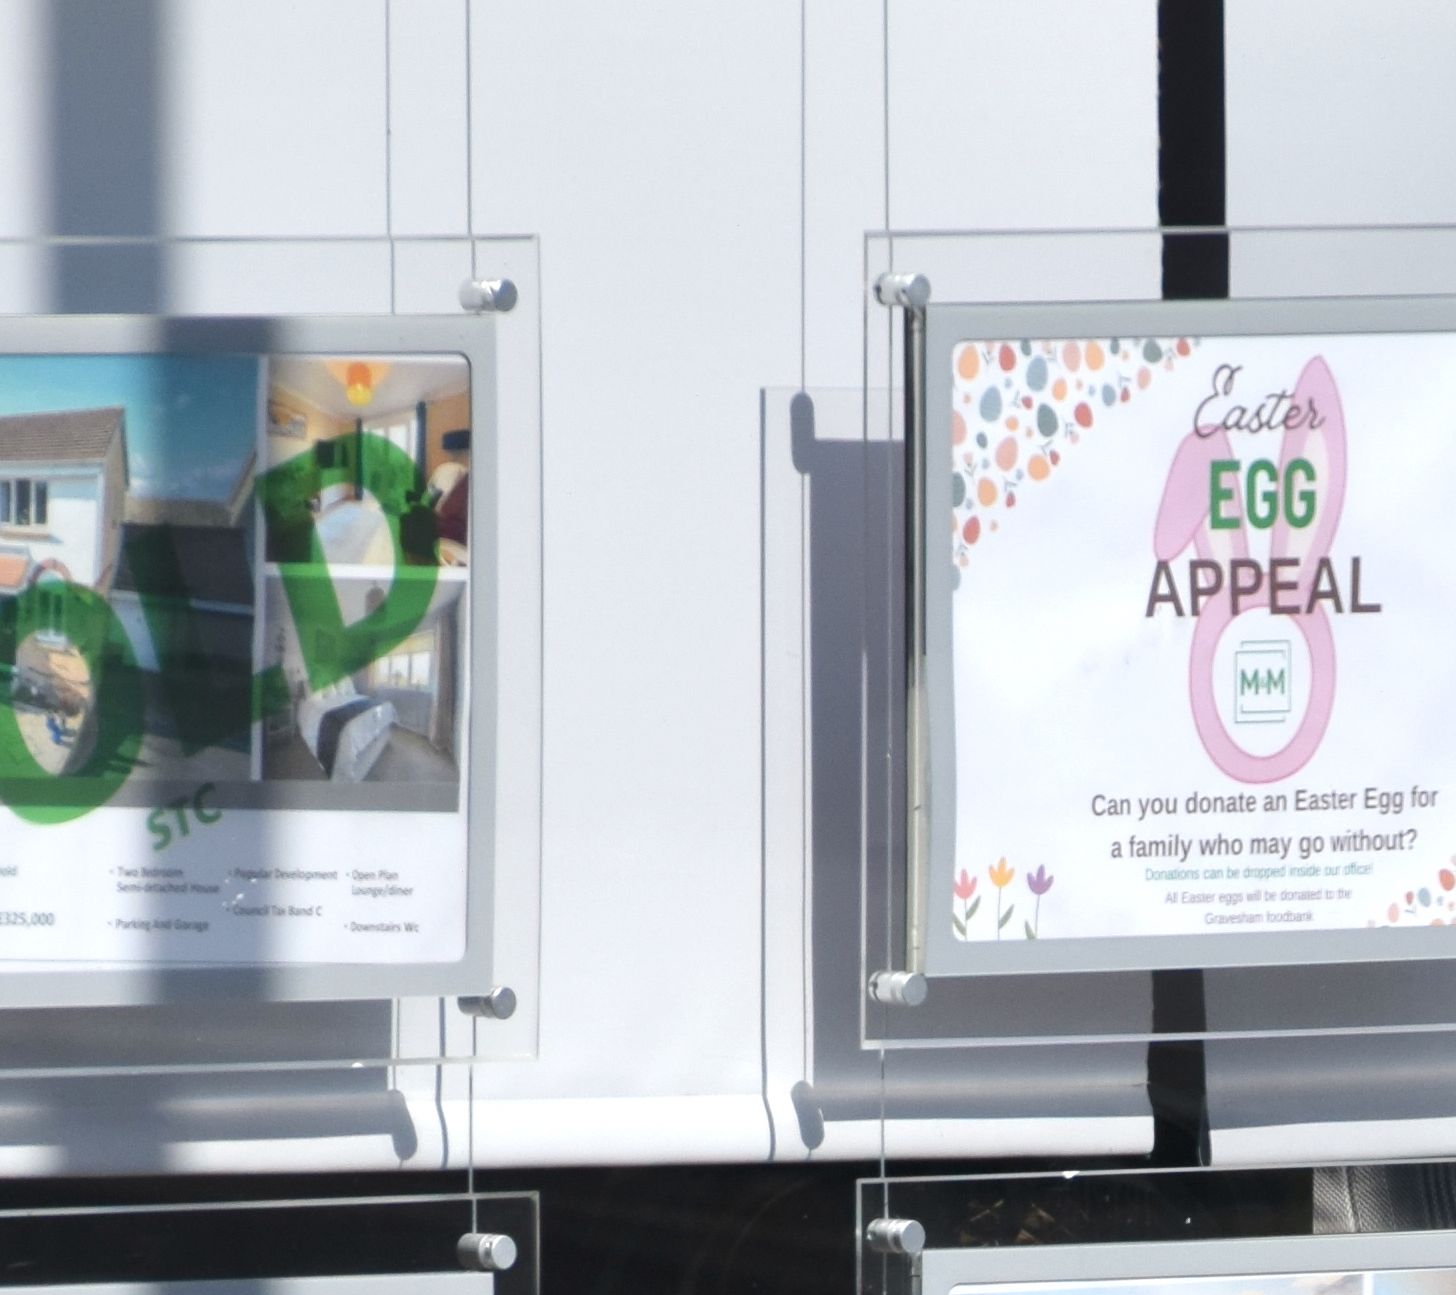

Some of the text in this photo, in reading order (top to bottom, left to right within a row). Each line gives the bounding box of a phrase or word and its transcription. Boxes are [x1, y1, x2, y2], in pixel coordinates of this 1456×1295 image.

[1195, 364, 1326, 440] Easter
[1209, 457, 1317, 530] EGG
[1145, 557, 1382, 618] APPEAL
[147, 782, 222, 850] STC
[1092, 786, 1438, 821] Can you donate an Easter Egg for
[1111, 828, 1418, 863] a family who may go without?
[1145, 867, 1199, 881] Donations
[1203, 868, 1223, 880] can
[1227, 867, 1240, 879] be
[1243, 866, 1286, 880] dropped
[1290, 865, 1321, 877] inside
[1182, 891, 1215, 904] Easter
[1219, 892, 1243, 906] eggs
[1280, 888, 1322, 901] donated
[1205, 911, 1264, 925] Gravesham
